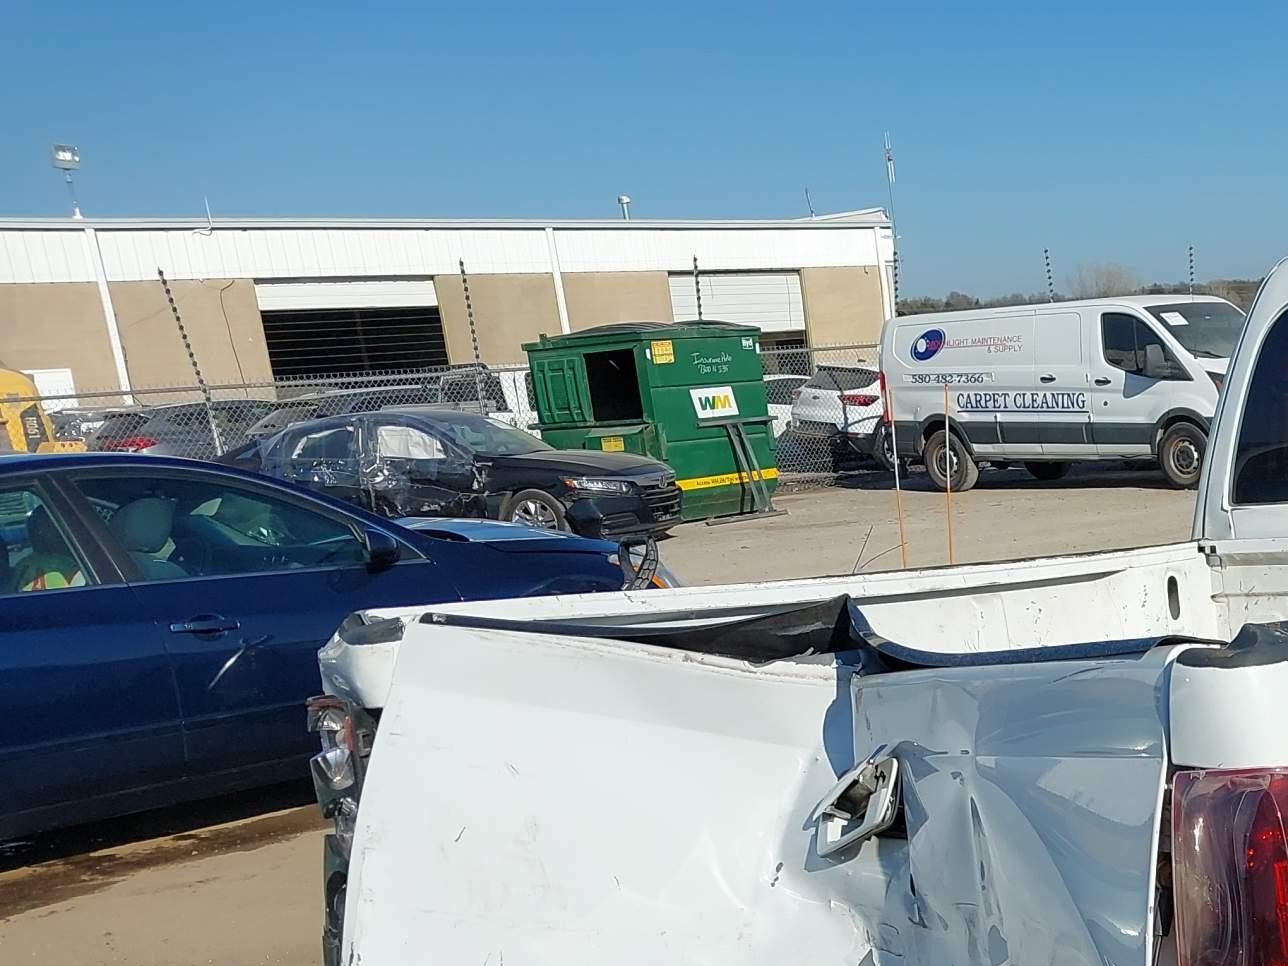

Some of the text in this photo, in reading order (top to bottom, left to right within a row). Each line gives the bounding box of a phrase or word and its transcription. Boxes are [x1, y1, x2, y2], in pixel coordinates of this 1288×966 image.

[971, 335, 1022, 345] MAINTENANCE
[994, 344, 1023, 353] SUPPLY
[911, 374, 984, 384] 580-482-7366
[698, 394, 732, 411] WM
[957, 392, 1086, 409] CARPET CLEANING
